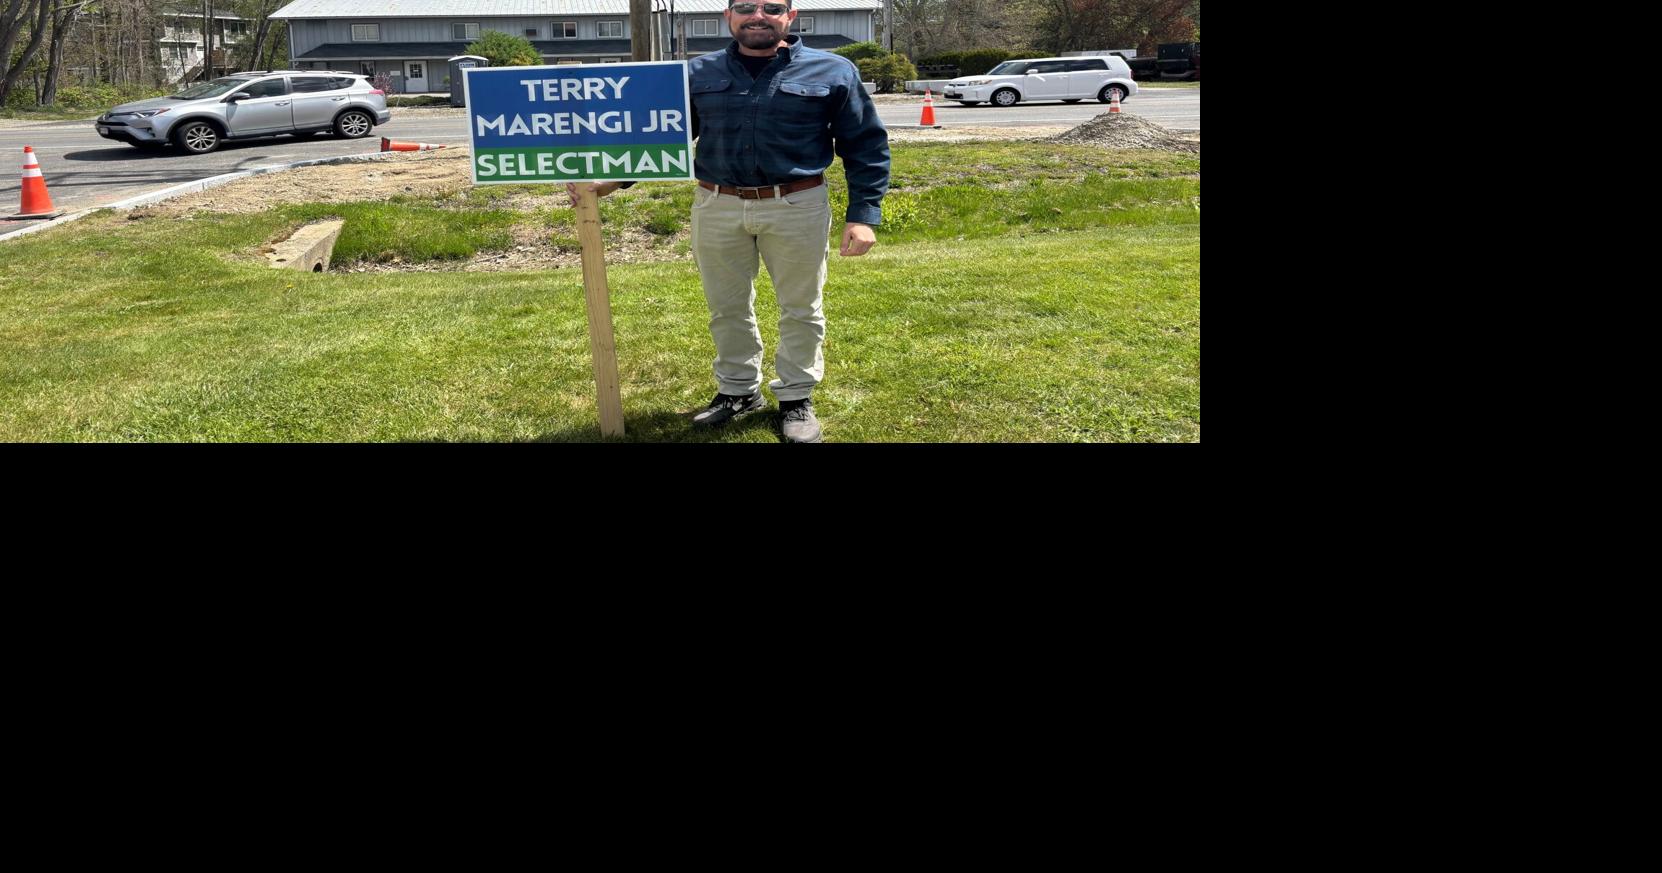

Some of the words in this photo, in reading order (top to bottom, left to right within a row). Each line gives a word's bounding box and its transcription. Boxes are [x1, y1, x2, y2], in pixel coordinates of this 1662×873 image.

[520, 76, 631, 102] TERRY
[476, 110, 633, 137] MARENGI
[642, 109, 684, 132] JR
[477, 150, 688, 176] SELECTMAN
